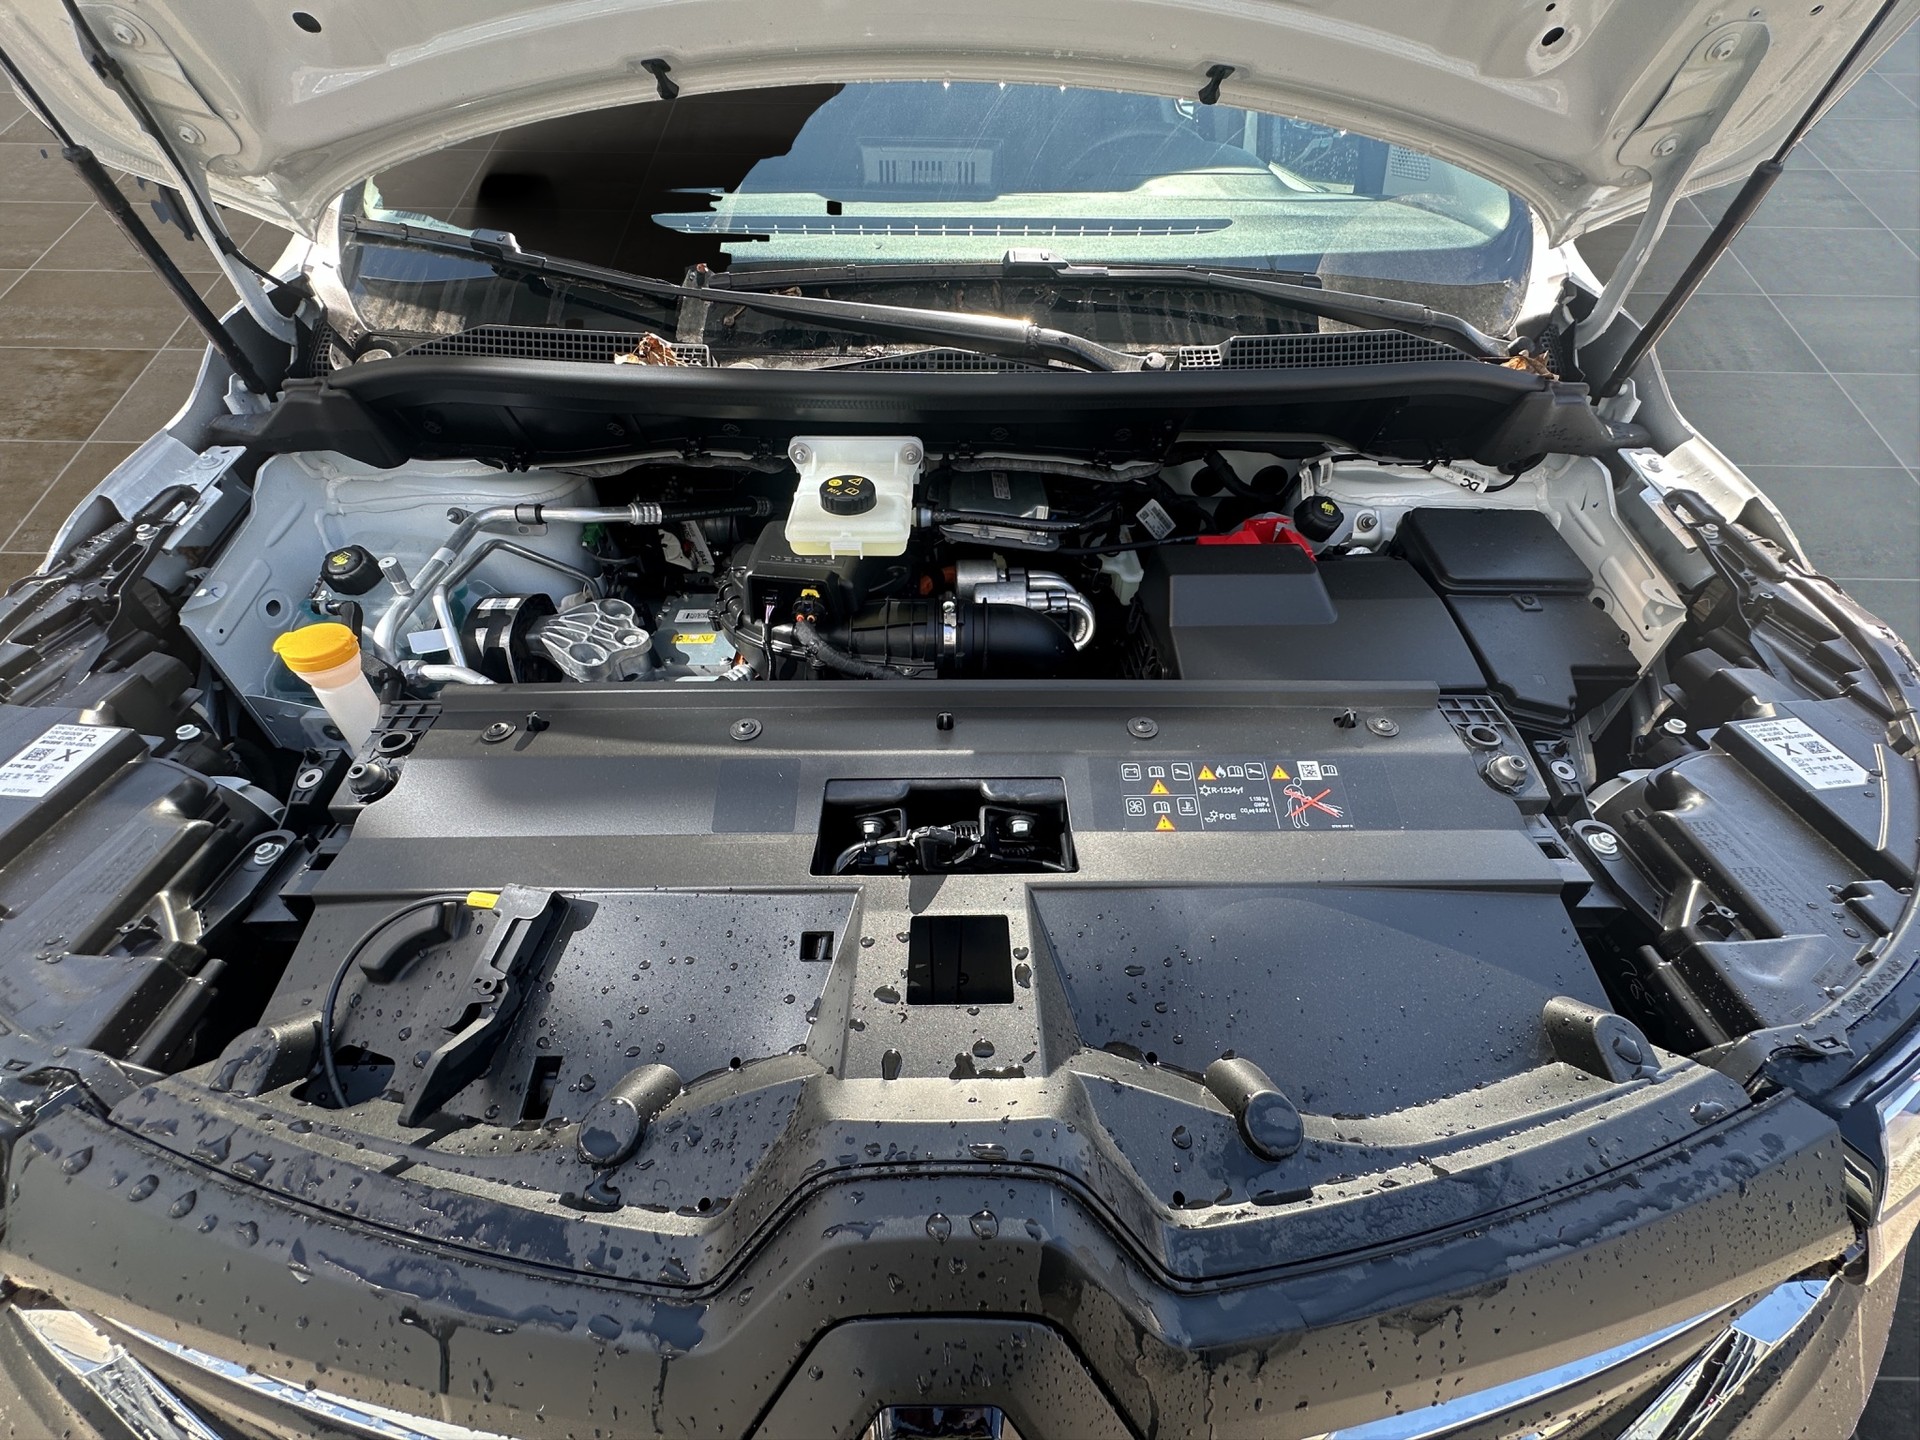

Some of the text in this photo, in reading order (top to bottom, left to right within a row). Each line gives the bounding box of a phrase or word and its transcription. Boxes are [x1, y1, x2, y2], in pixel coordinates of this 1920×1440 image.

[1460, 478, 1480, 491] DC
[1782, 726, 1799, 735] L
[80, 734, 97, 742] R
[53, 748, 82, 762] X
[1774, 743, 1803, 756] X
[1211, 786, 1244, 795] R-1234yf
